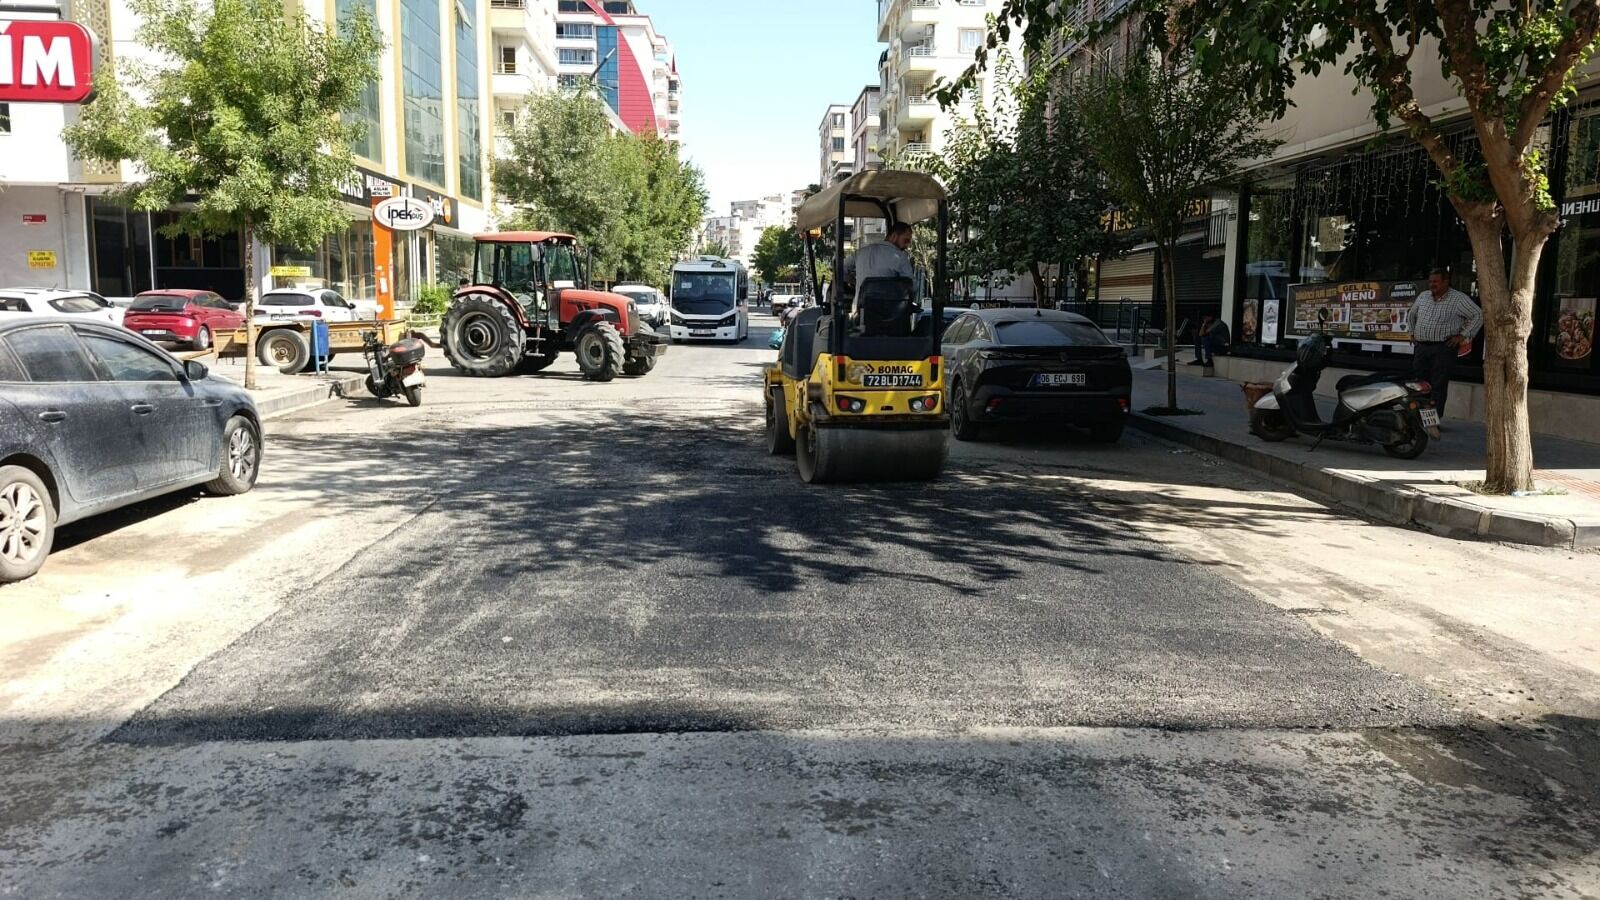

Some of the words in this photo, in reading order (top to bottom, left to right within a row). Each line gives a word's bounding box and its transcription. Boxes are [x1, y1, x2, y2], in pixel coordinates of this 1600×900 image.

[878, 365, 914, 374] BOMAG
[1041, 374, 1050, 383] 06
[1053, 374, 1068, 383] ECJ
